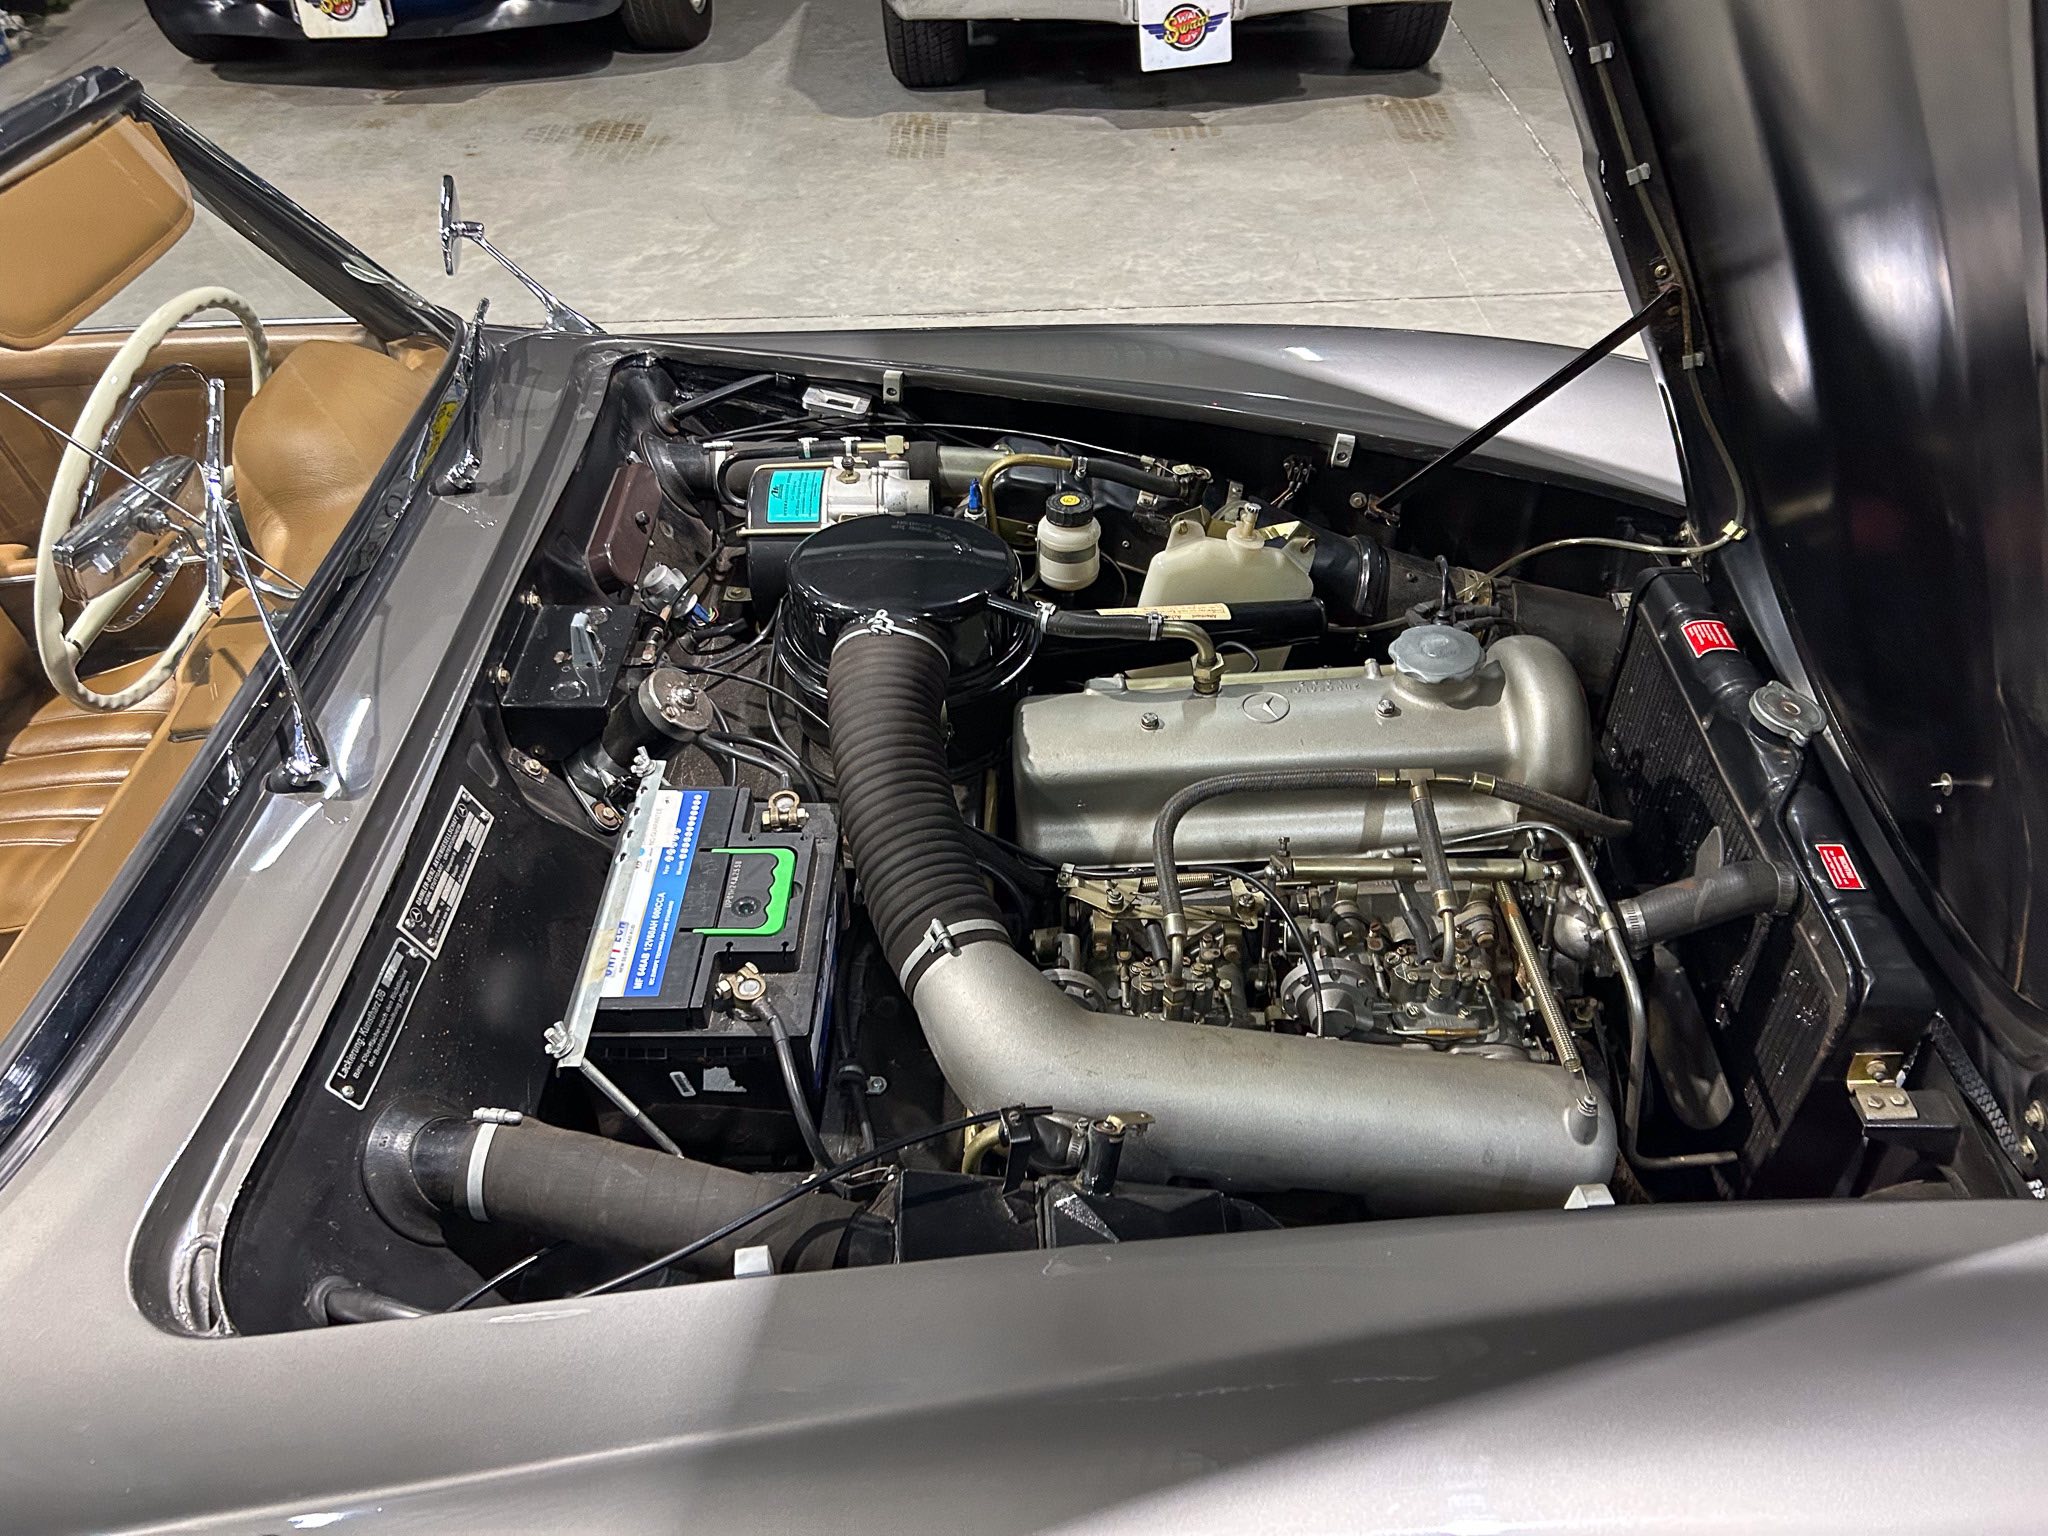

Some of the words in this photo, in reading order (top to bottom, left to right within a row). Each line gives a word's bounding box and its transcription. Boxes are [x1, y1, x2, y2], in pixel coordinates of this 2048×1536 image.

[632, 977, 644, 989] MF
[337, 1036, 366, 1079] Lackierung:
[359, 1002, 381, 1036] Kunstharz
